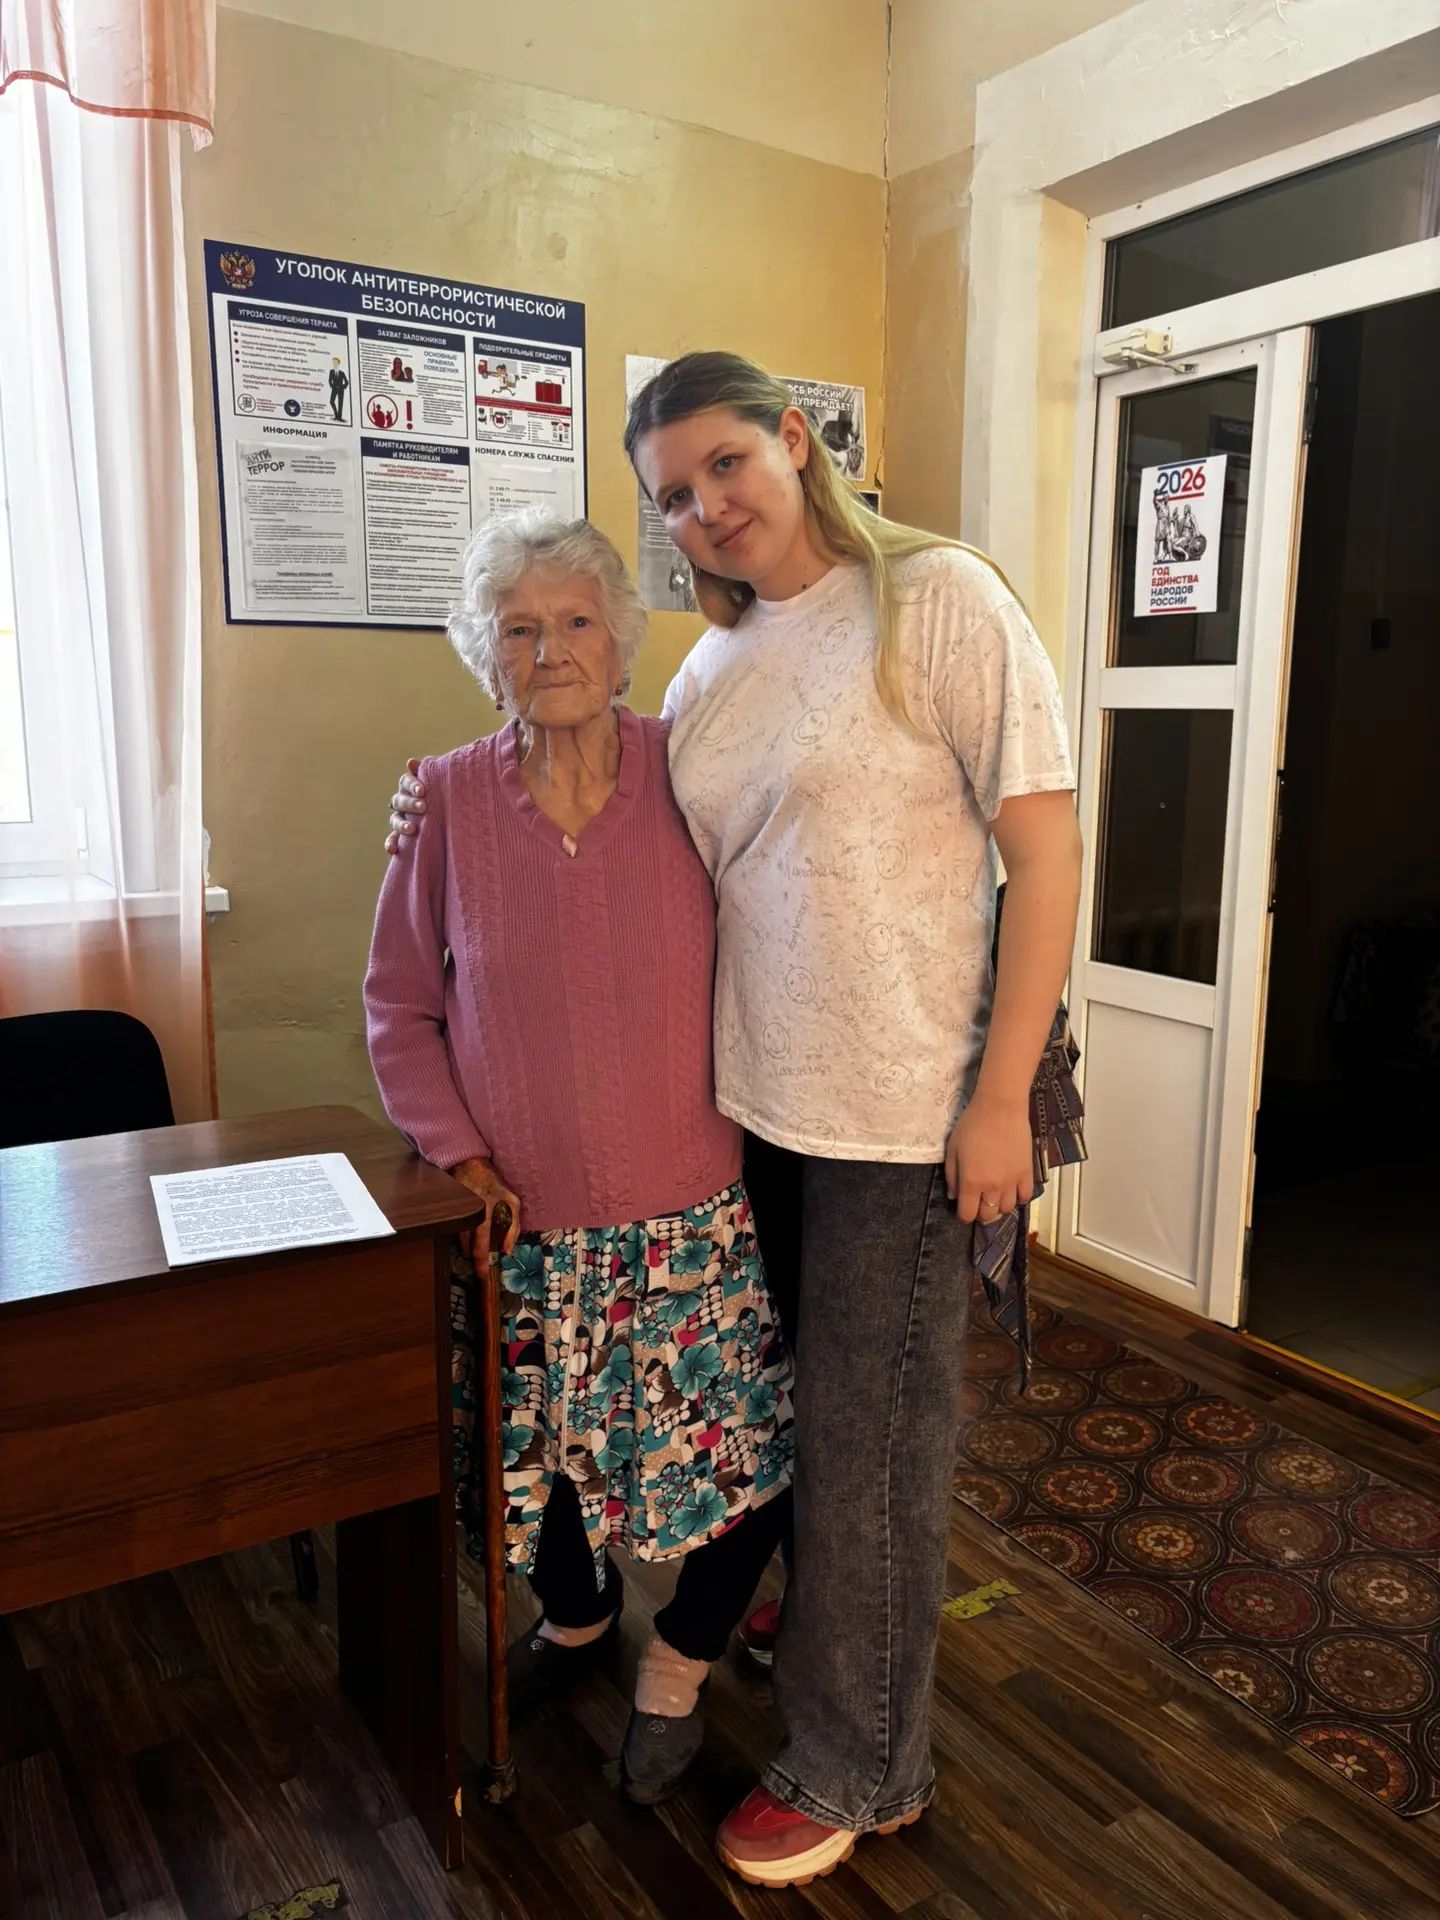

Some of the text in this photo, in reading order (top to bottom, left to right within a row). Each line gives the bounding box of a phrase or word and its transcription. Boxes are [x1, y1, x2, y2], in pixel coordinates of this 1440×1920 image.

[275, 257, 566, 320] УГОЛОК АНТИТЕРРОРИСТИЧЕСКОЙ
[361, 294, 496, 329] БЕЗОПАСНОСТИ
[238, 308, 338, 329] УГРОЗА СОВЕРШЕНИЯ ТЕРАКТА
[377, 329, 447, 345] ЗАХВАТ ЗАЛОЖНИКОВ
[424, 350, 458, 360] ОСНОВНЫЕ
[479, 343, 567, 362] ПОДОЗРИТЕЛЬНЫЕ ПРЕДМЕТЫ
[423, 364, 459, 374] ПОВЕДЕНИЯ
[427, 358, 455, 367] ПРАВИЛА
[807, 387, 842, 399] РОССИИ
[791, 396, 855, 412] ДУПРЕЖДАЕТ!
[263, 425, 328, 438] ИНФОРМАЦИЯ
[373, 440, 459, 455] ПАМЯТКА РУКОВОДИТЕЛЯМ
[399, 452, 441, 462] РАБОТНИКАМ
[475, 447, 575, 464] НОМЕРА СЛУЖБ СПАСЕНИЯ
[247, 461, 285, 475] ТЕРРОР
[1156, 466, 1206, 496] 2026
[1152, 566, 1169, 576] ГОД
[1151, 574, 1199, 587] ЕДИНСТВА
[1151, 585, 1193, 597] НАРОДОВ
[1150, 596, 1187, 607] РОССИИ
